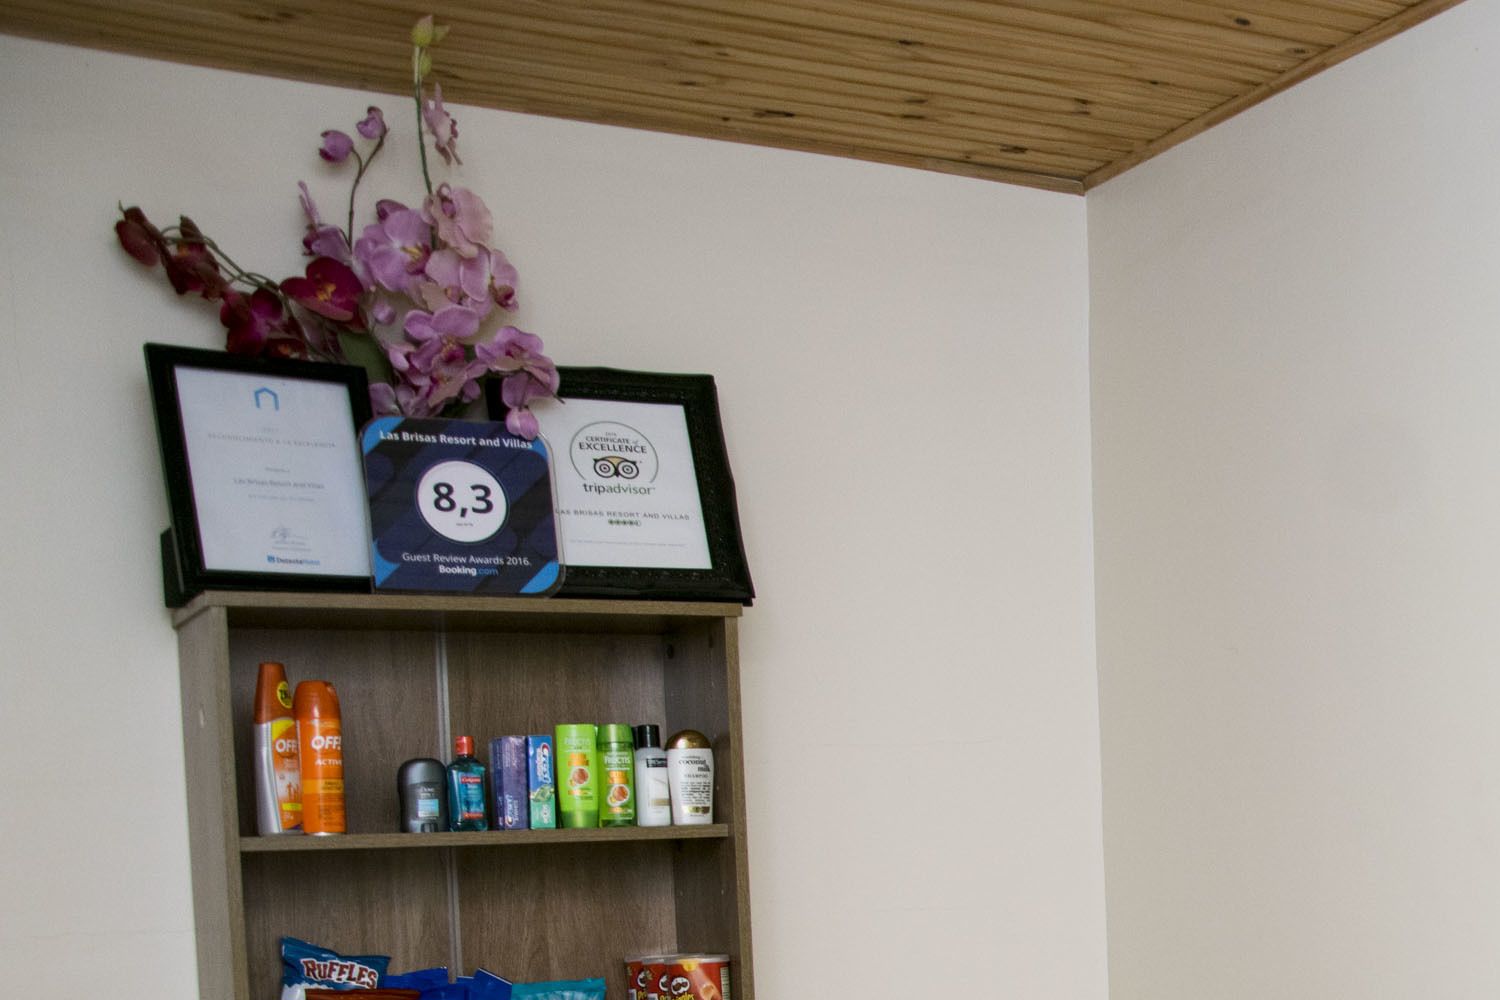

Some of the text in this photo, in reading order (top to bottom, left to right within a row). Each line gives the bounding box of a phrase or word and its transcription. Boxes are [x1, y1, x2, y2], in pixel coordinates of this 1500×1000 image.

[379, 430, 533, 450] Las Brisas Resort and Villas
[585, 435, 630, 445] CERTIFICATE
[578, 441, 648, 454] EXCELLENCE
[582, 483, 651, 495] tripadvisor
[432, 481, 494, 519] 8,3
[606, 510, 640, 518] RESORT
[402, 552, 431, 563] Guest
[433, 553, 467, 564] Review
[468, 555, 504, 565] Awards
[439, 565, 499, 577] Booking.com
[678, 759, 706, 768] coconut
[301, 957, 380, 990] RUFFLES
